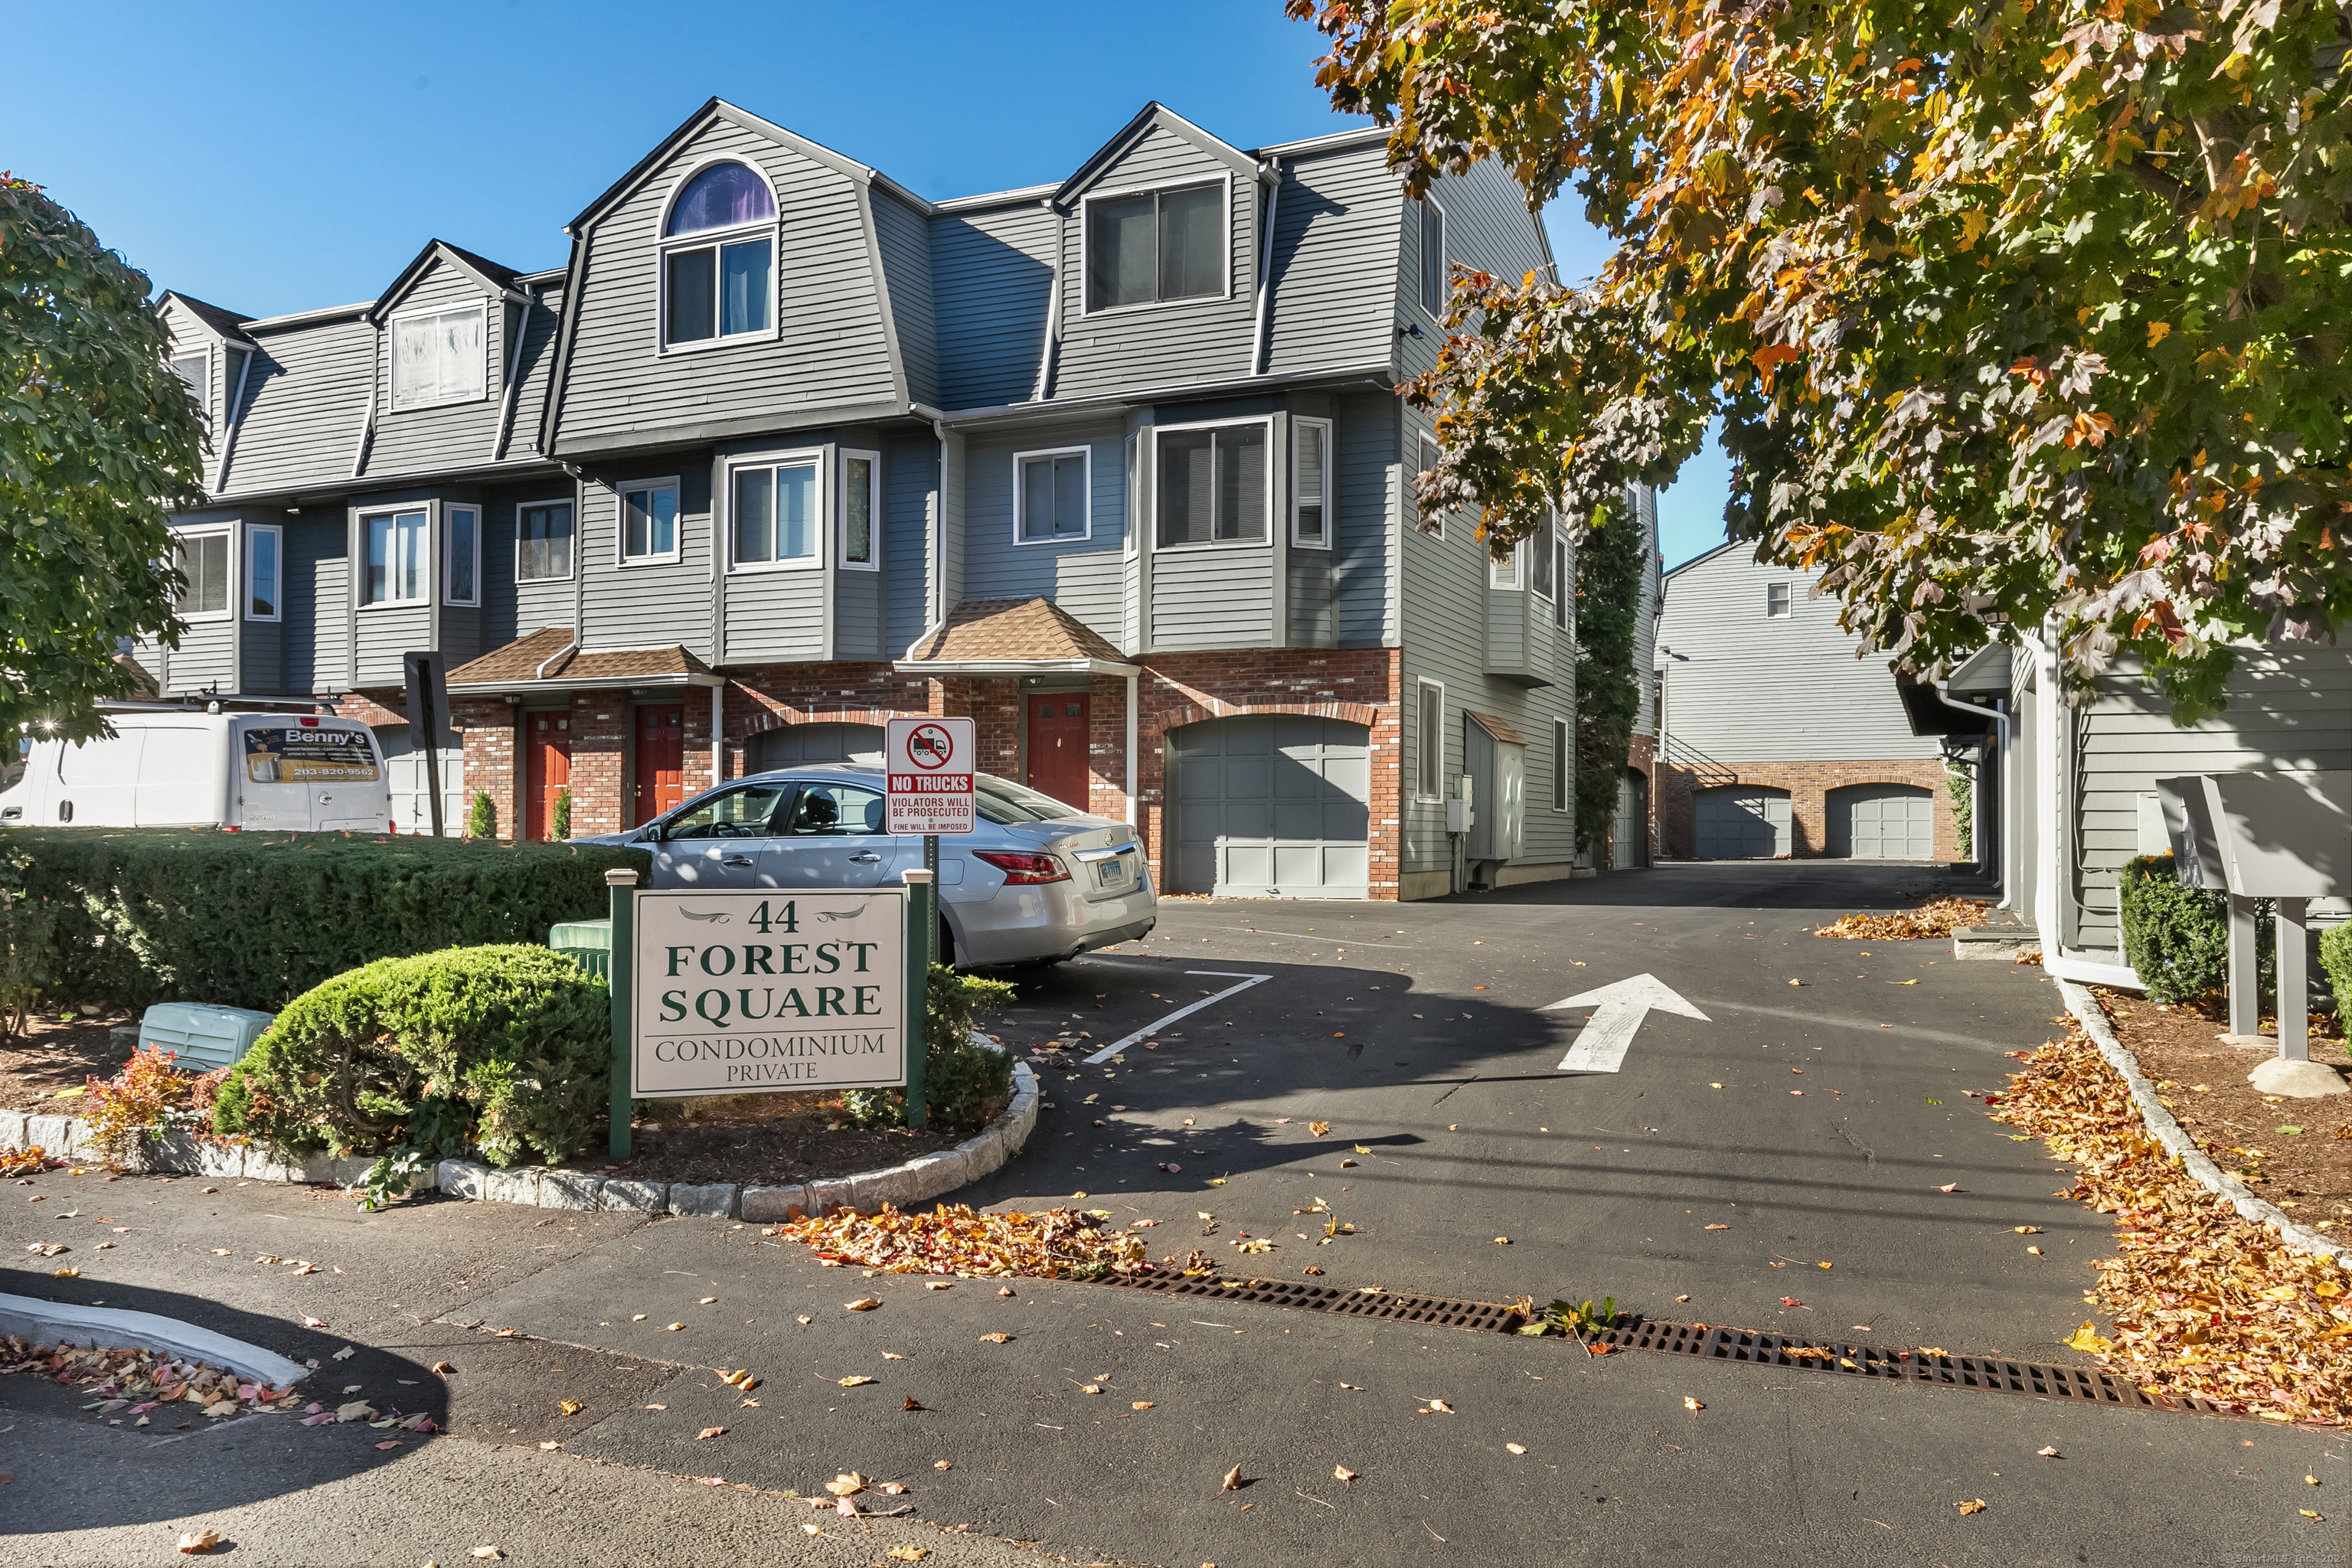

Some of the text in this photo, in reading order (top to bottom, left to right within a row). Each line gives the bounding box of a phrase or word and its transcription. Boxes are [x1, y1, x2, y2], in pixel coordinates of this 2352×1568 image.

[286, 730, 364, 745] Benny's
[892, 776, 969, 792] NO TRUCKS
[891, 798, 970, 807] VIOLATORS WILL
[893, 808, 969, 817] BE PROSECUTED
[748, 900, 799, 934] 44
[665, 942, 878, 976] FOREST
[659, 985, 882, 1028] SQUARE
[655, 1034, 885, 1063] CONDOMINIUM
[727, 1062, 818, 1082] PRIVATE
